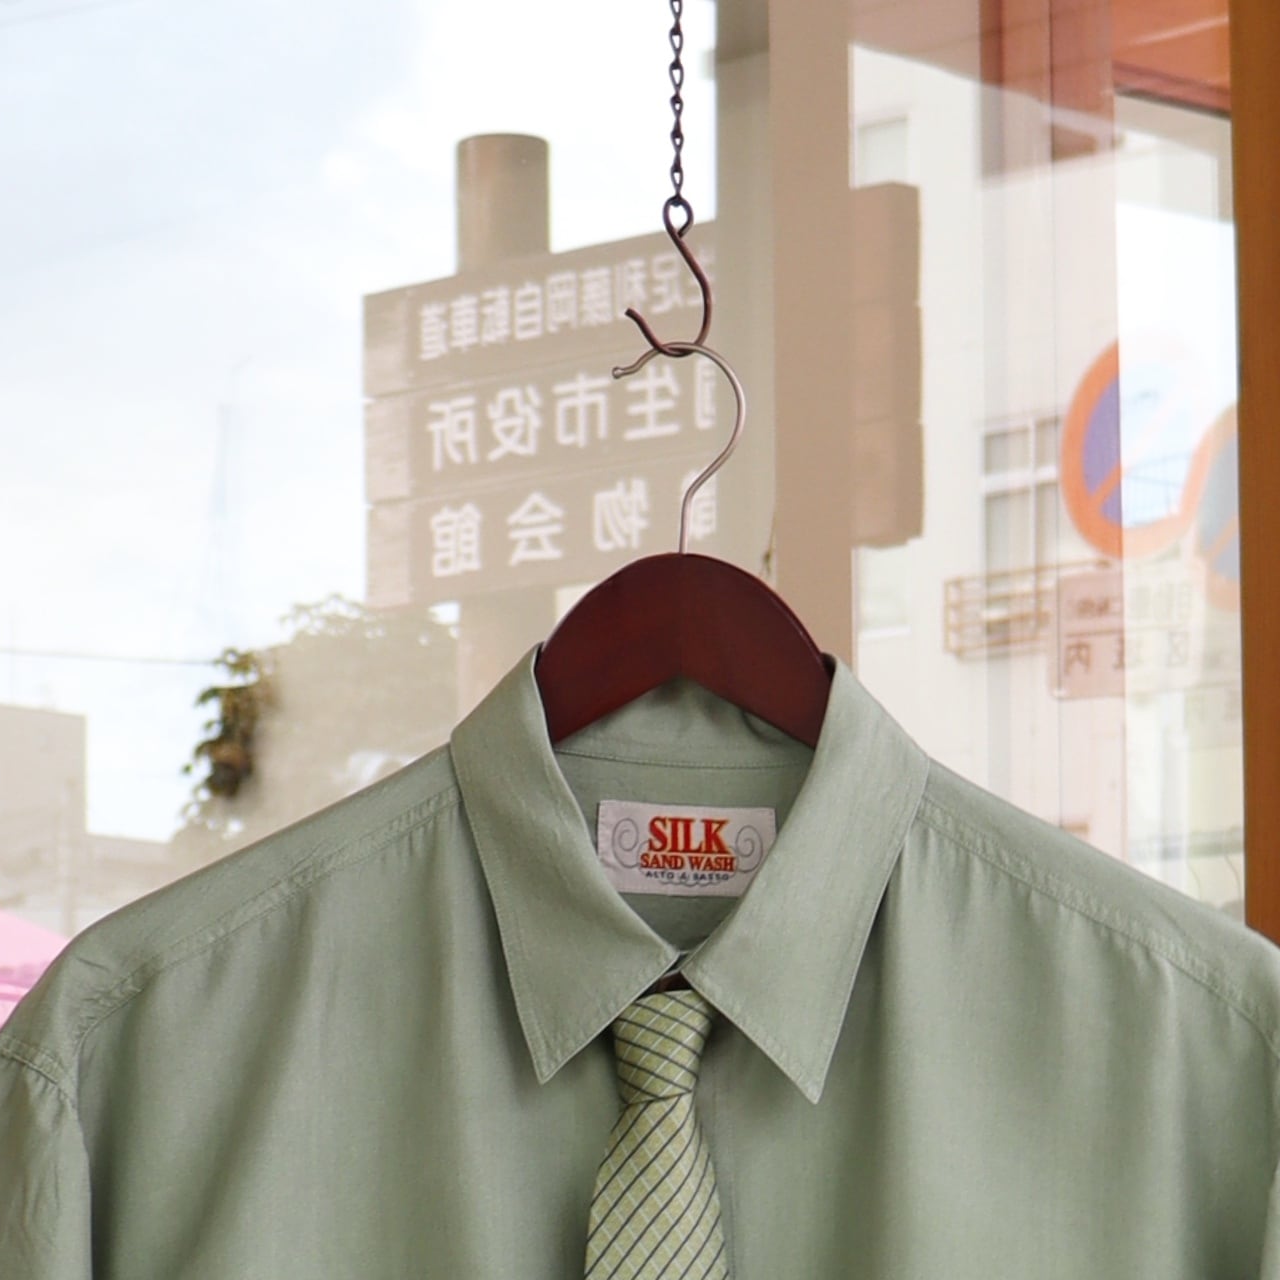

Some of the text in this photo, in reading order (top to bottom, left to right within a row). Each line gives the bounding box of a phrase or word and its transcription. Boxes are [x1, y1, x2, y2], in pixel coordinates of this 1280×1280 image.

[648, 816, 730, 854] SILK
[640, 853, 736, 872] SAND WASH
